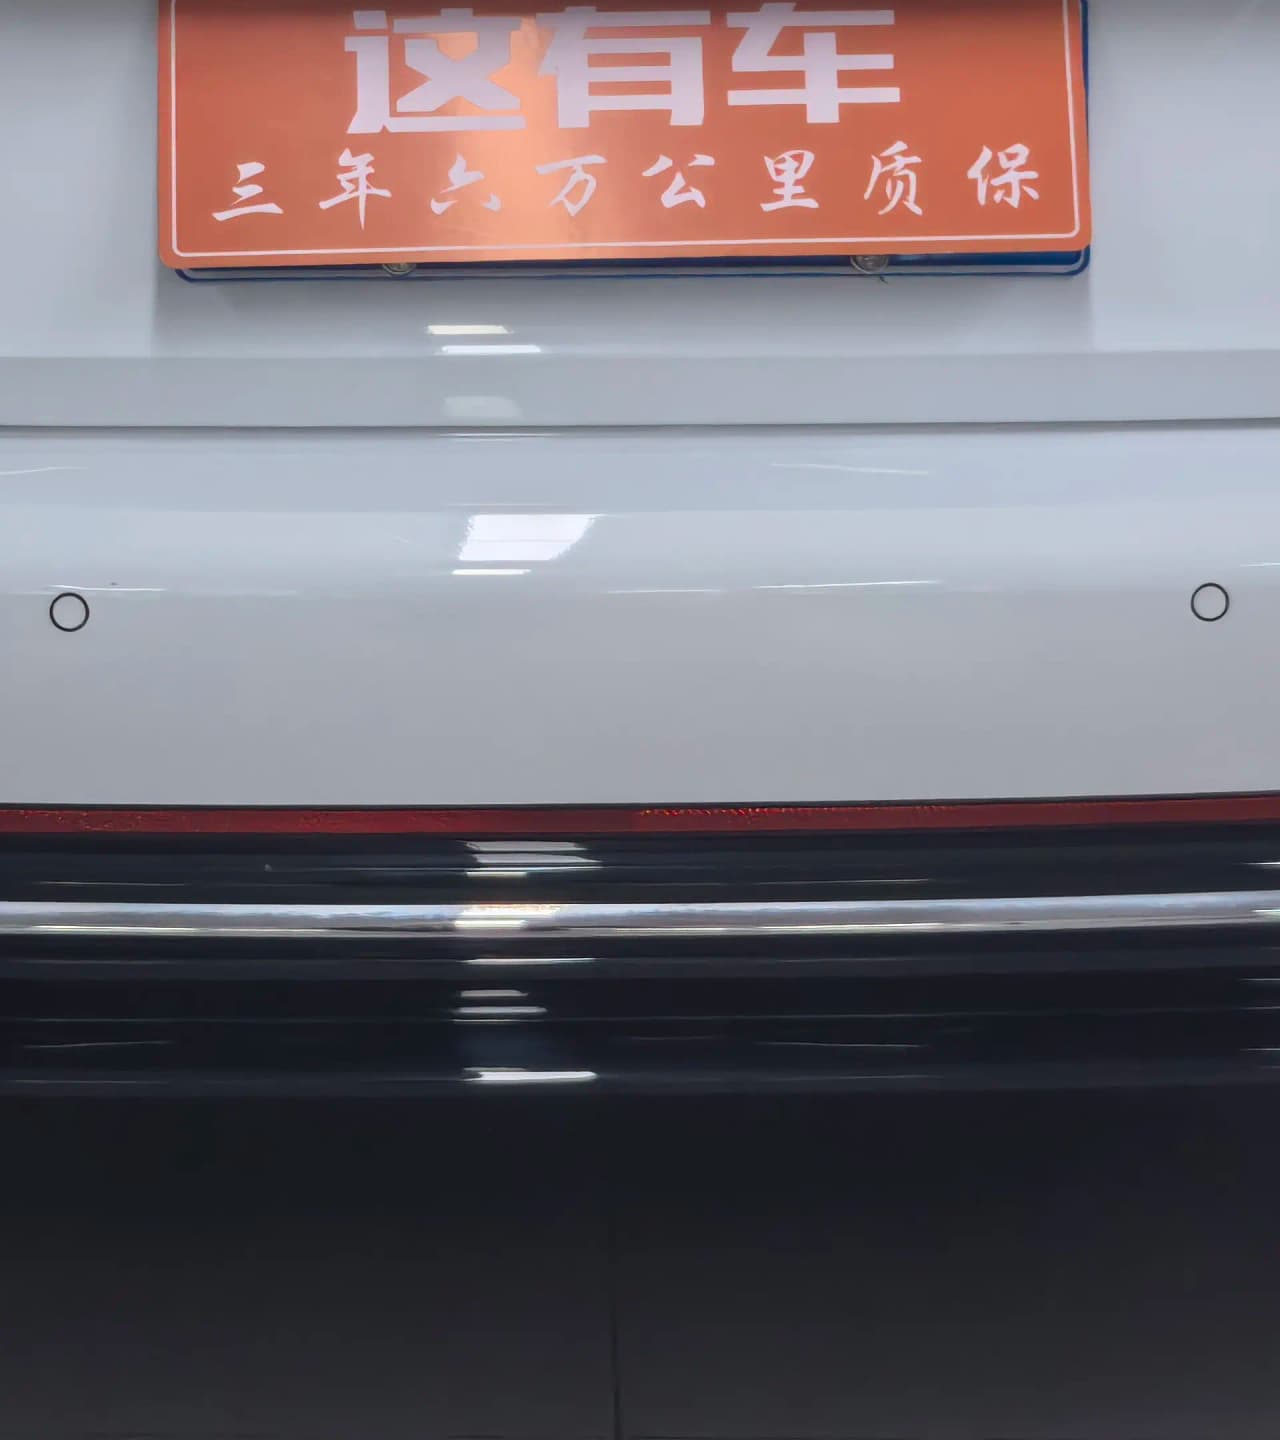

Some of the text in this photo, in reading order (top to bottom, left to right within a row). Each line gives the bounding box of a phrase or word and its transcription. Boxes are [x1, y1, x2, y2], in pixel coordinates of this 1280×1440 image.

[344, 2, 901, 135] 这有车
[211, 140, 1042, 229] 三年六万公里质保
